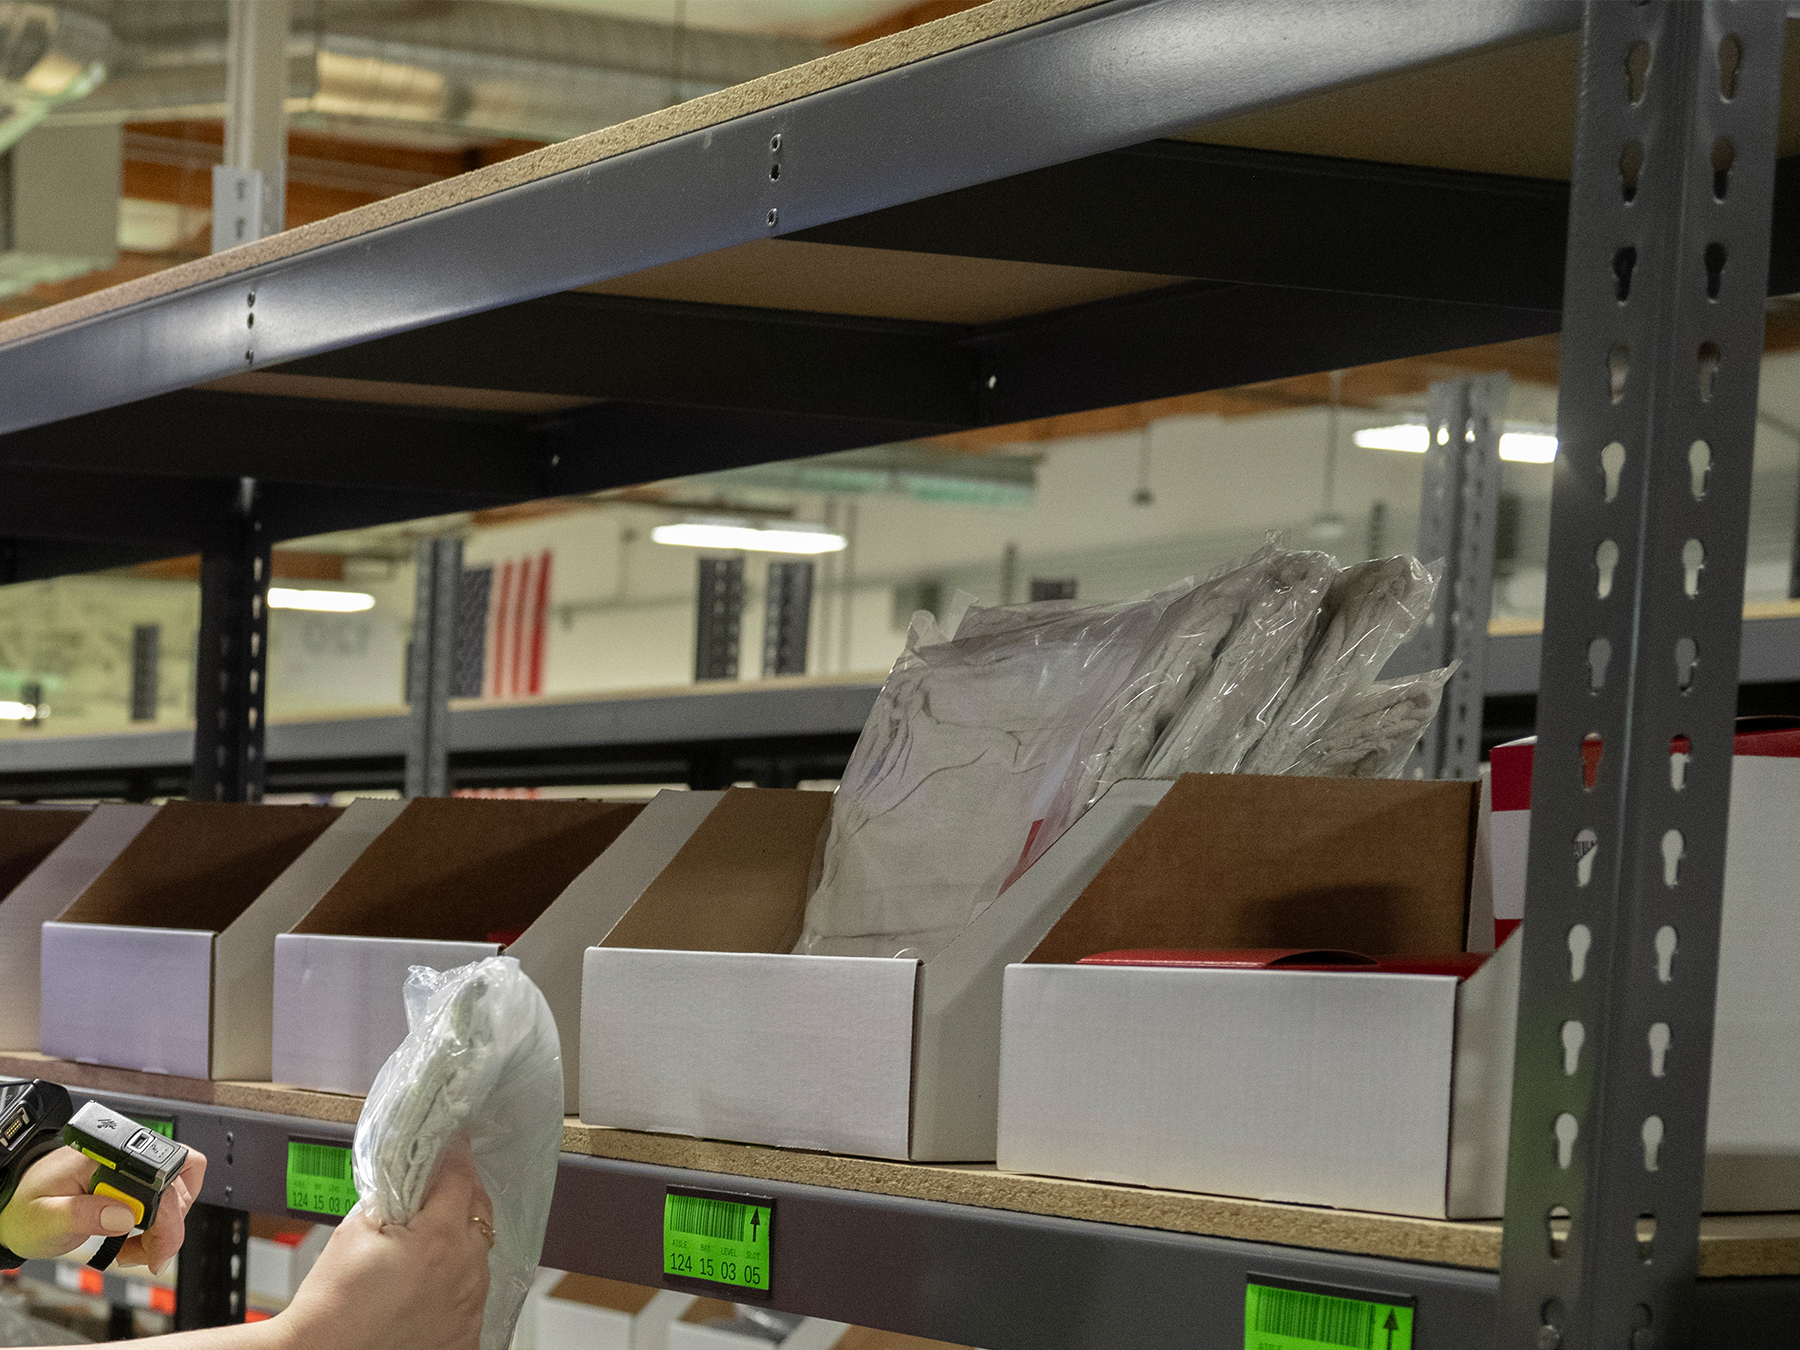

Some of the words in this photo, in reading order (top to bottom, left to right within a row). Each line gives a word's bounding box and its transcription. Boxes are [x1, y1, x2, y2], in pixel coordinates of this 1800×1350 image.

[293, 1192, 308, 1207] 124
[314, 1195, 324, 1210] 15
[329, 1197, 339, 1213] 03
[721, 1247, 738, 1257] LEVEL
[671, 1252, 692, 1272] 124
[700, 1257, 714, 1277] 15
[721, 1261, 736, 1280] 03
[744, 1265, 760, 1285] 05
